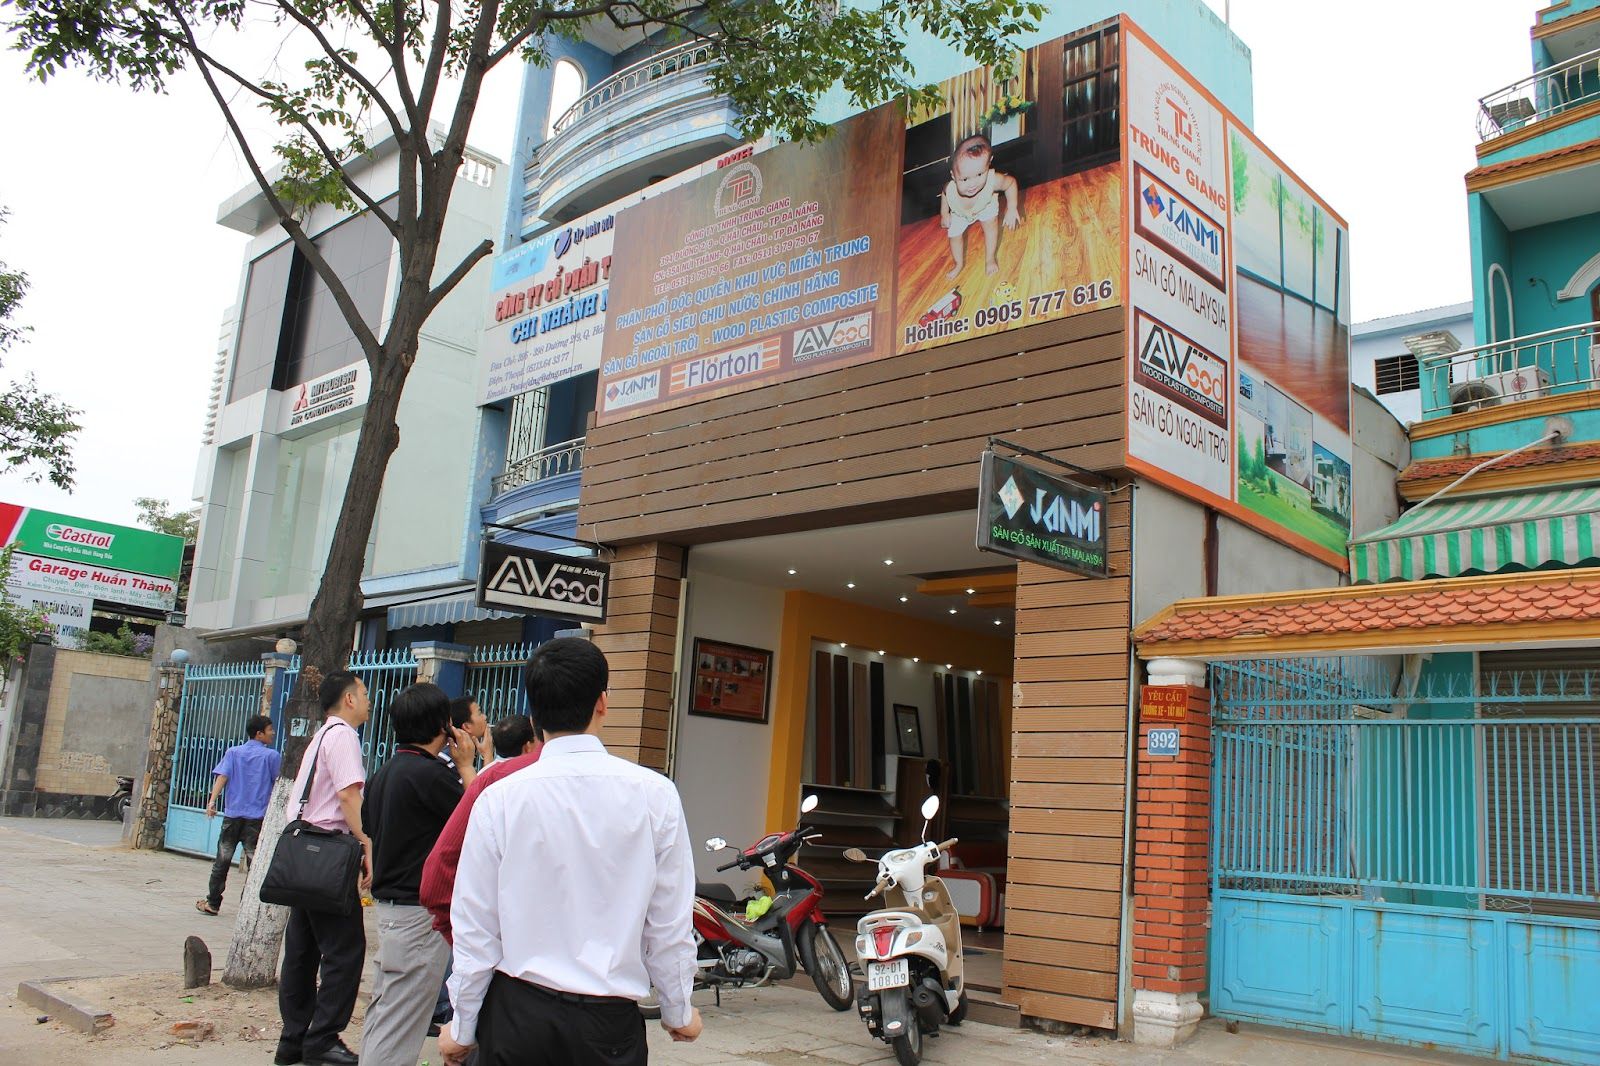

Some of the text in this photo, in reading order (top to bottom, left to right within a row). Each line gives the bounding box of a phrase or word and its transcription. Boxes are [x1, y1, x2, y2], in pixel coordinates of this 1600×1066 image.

[1130, 123, 1180, 175] TRÙNG
[1185, 168, 1226, 211] GIANG
[685, 198, 790, 243] CÔNG TY TNHH TRÙNG GIANG
[770, 216, 781, 227] TP
[782, 209, 793, 222] ĐÀ
[774, 228, 785, 239] TP
[787, 221, 798, 236] ĐÀ
[719, 262, 730, 273] 66
[733, 255, 751, 268] FAX:
[752, 247, 772, 261] 0511
[774, 244, 781, 254] 3
[782, 240, 793, 252] 79
[796, 236, 806, 248] 79
[808, 231, 820, 244] 67
[496, 293, 525, 321] CÔNG
[527, 284, 545, 309] TY
[545, 265, 564, 302] CỔ
[564, 257, 599, 294] PHẦN
[616, 308, 642, 329] PHÂN
[670, 292, 692, 312] ĐỘC
[695, 277, 732, 304] QUYỀN
[734, 271, 759, 292] KHU
[761, 261, 786, 283] VỰC
[788, 248, 822, 275] MIỀN
[824, 235, 871, 263] TRUNG
[1136, 245, 1157, 286] SÀN
[1179, 275, 1227, 331] MALAYSIA
[511, 316, 538, 344] CHI
[541, 296, 599, 334] NHÁNH
[633, 327, 654, 346] SÀN
[672, 312, 697, 333] SIÊU
[699, 304, 726, 325] CHỊU
[727, 292, 760, 316] NƯỚC
[763, 280, 801, 306] CHÍNH
[804, 270, 840, 294] HÃNG
[905, 280, 1113, 344] Hotline: 0905 777 616
[603, 358, 624, 376] SÀN
[640, 341, 671, 364] NGOÀI
[674, 333, 699, 355] TRỜI
[711, 322, 746, 344] WOOD
[749, 306, 800, 334] PLASTIC
[802, 283, 879, 319] COMPOSITE
[561, 352, 570, 362] 77
[688, 350, 759, 387] Flörton
[311, 370, 357, 397] MITSUBISHI
[1141, 363, 1223, 415] WOOD PLASTIC COMPOSITE
[304, 397, 353, 420] CONDITIONERS
[1133, 390, 1155, 428] SÀN
[1176, 414, 1206, 453] NGOÀI
[1208, 431, 1229, 464] TRỜI
[61, 527, 112, 549] Castrol
[992, 524, 1009, 541] SÀN
[1071, 548, 1103, 567] MALAYSIA
[29, 559, 88, 581] Garage
[91, 570, 128, 586] Huấn
[132, 577, 172, 593] Thành
[583, 567, 606, 578] Decking
[1148, 690, 1164, 701] YÊU
[1151, 732, 1176, 748] 392
[873, 973, 906, 988] 108.09
